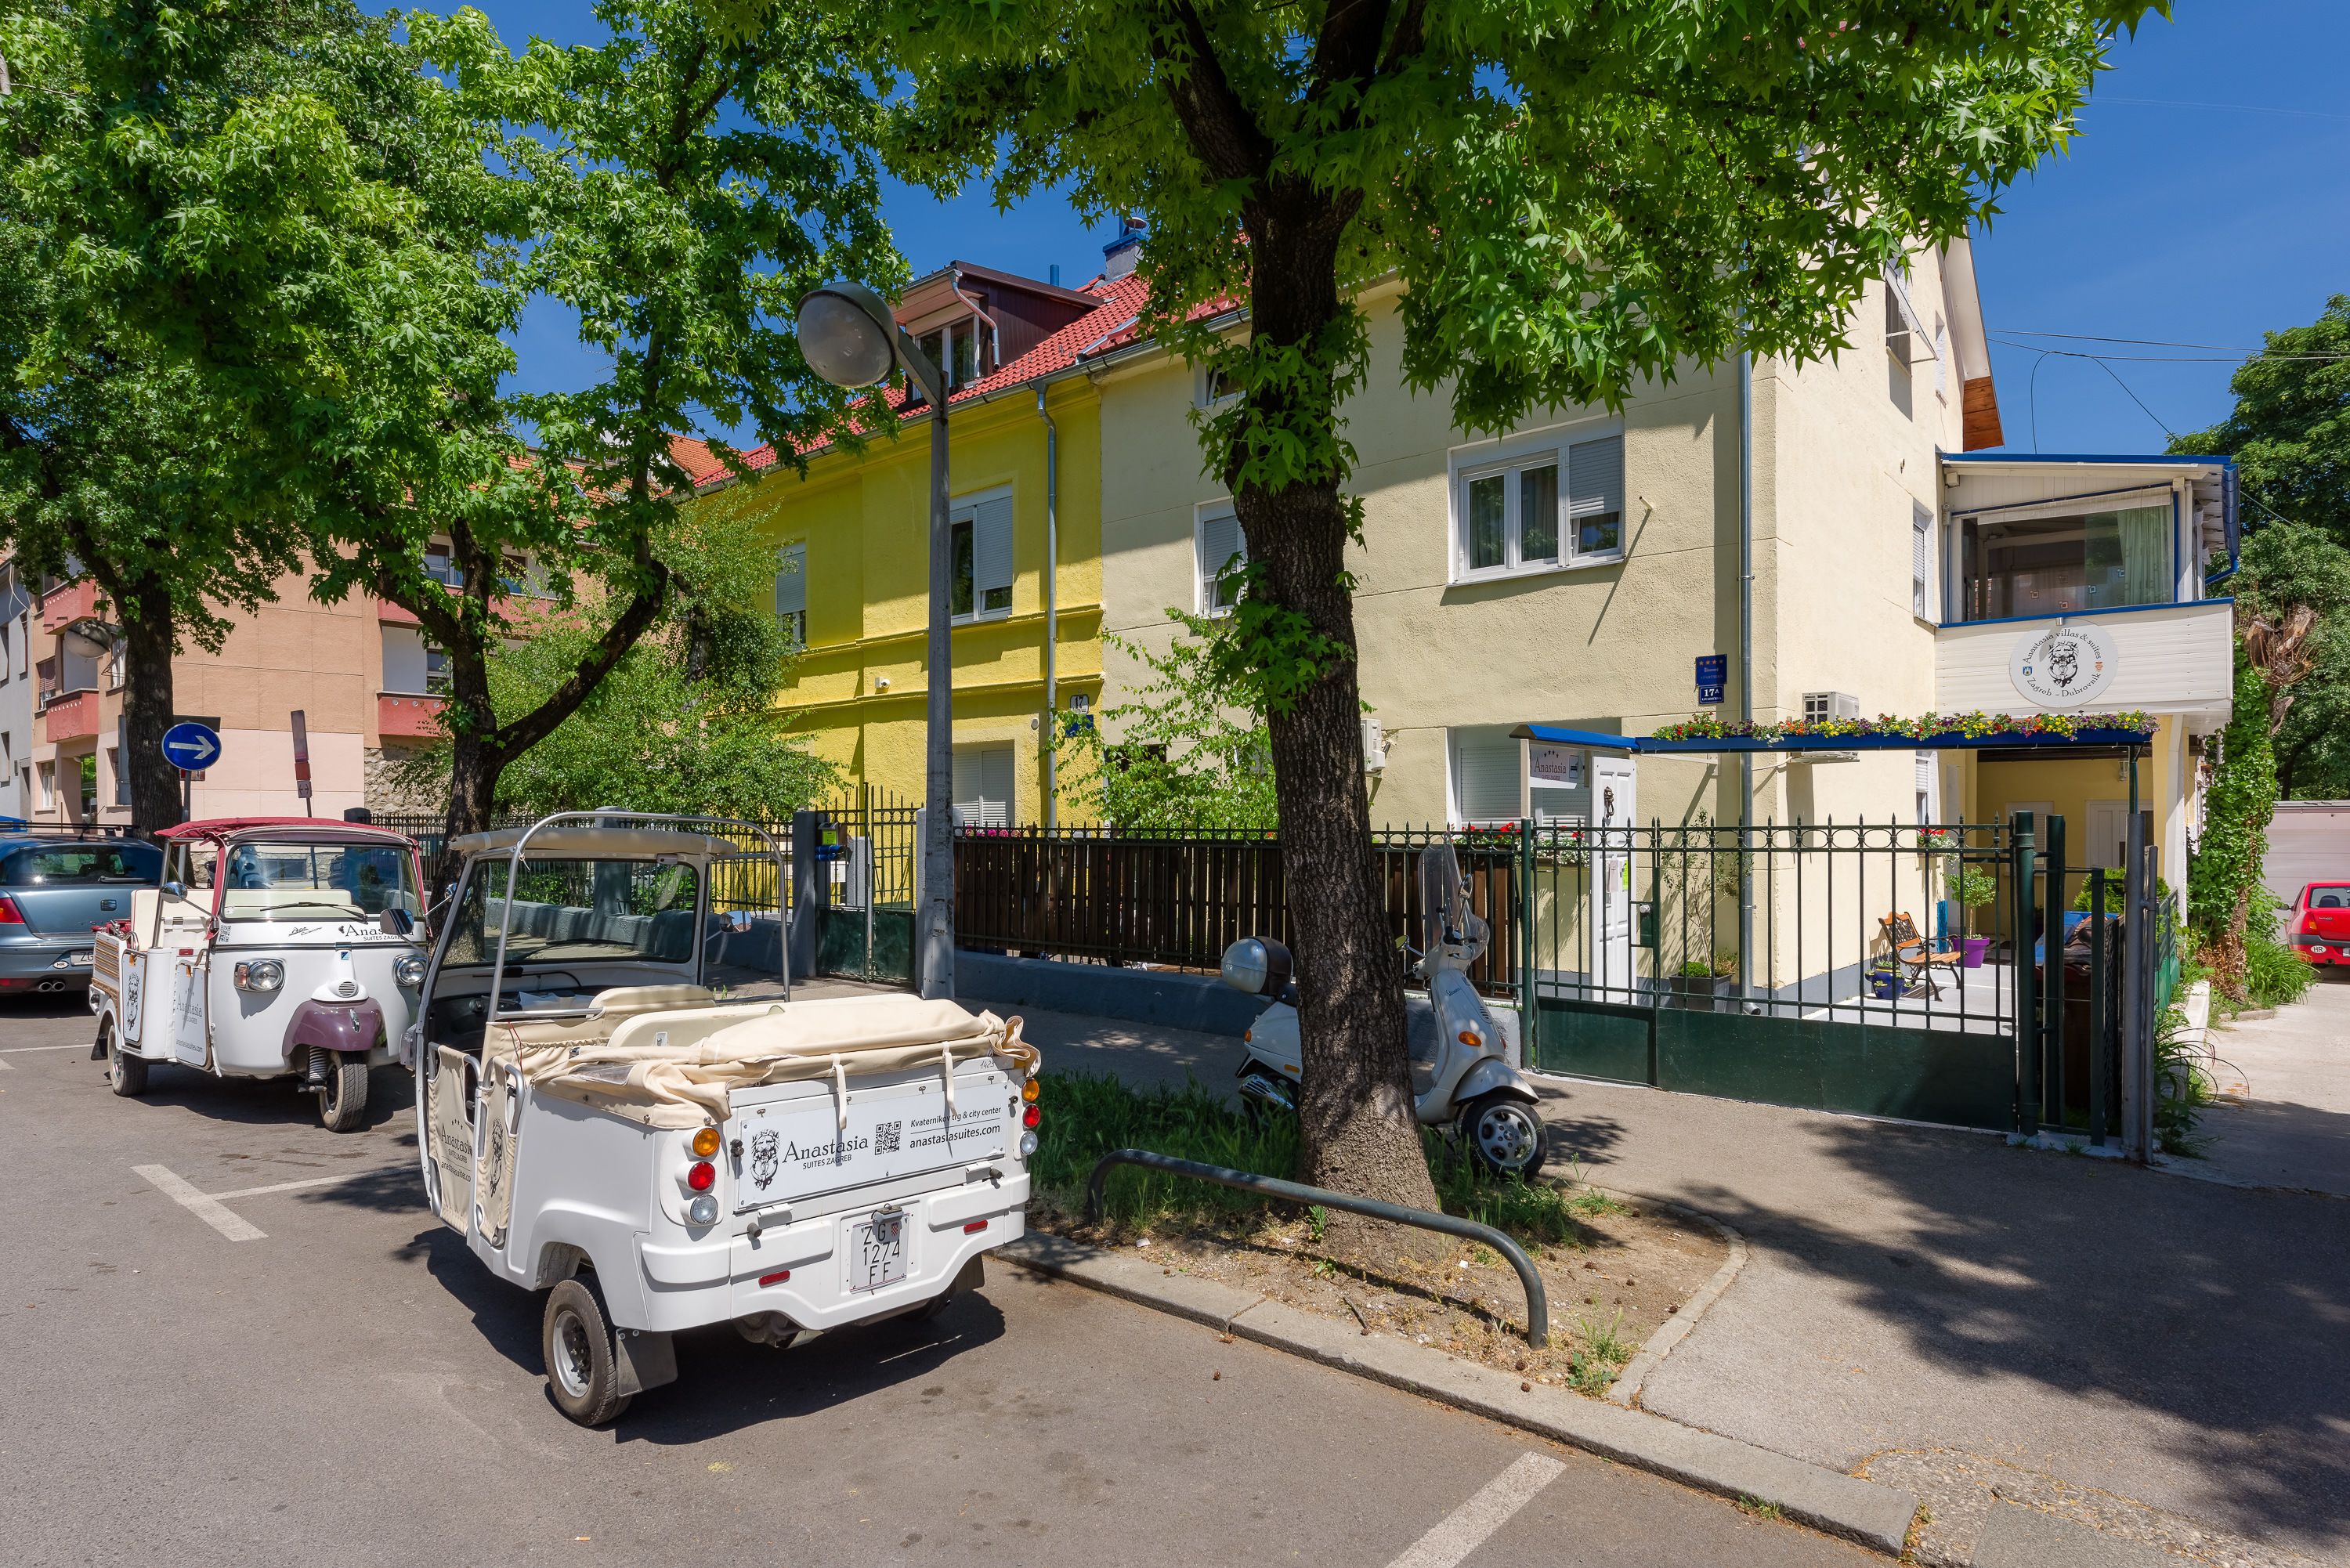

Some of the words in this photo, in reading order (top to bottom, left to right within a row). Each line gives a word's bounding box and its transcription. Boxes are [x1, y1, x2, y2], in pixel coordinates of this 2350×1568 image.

[2023, 634, 2054, 663] Anastasia
[2055, 629, 2078, 638] villas
[2087, 638, 2102, 659] suites
[2027, 677, 2052, 696] Zagreb
[2062, 673, 2101, 697] Dubrovnik
[1076, 696, 1083, 709] 17
[1534, 756, 1567, 774] Anastasia
[81, 951, 93, 961] ZG
[176, 992, 203, 1017] Anastasia
[911, 1115, 951, 1127] Kvaternikov
[969, 1110, 981, 1118] city
[982, 1107, 1001, 1115] center
[909, 1125, 1000, 1148] anastasiasuites.com
[783, 1136, 869, 1163] Anastasia
[802, 1159, 825, 1169] SUITES
[826, 1154, 852, 1165] ZAGREB
[863, 1240, 900, 1266] 1274
